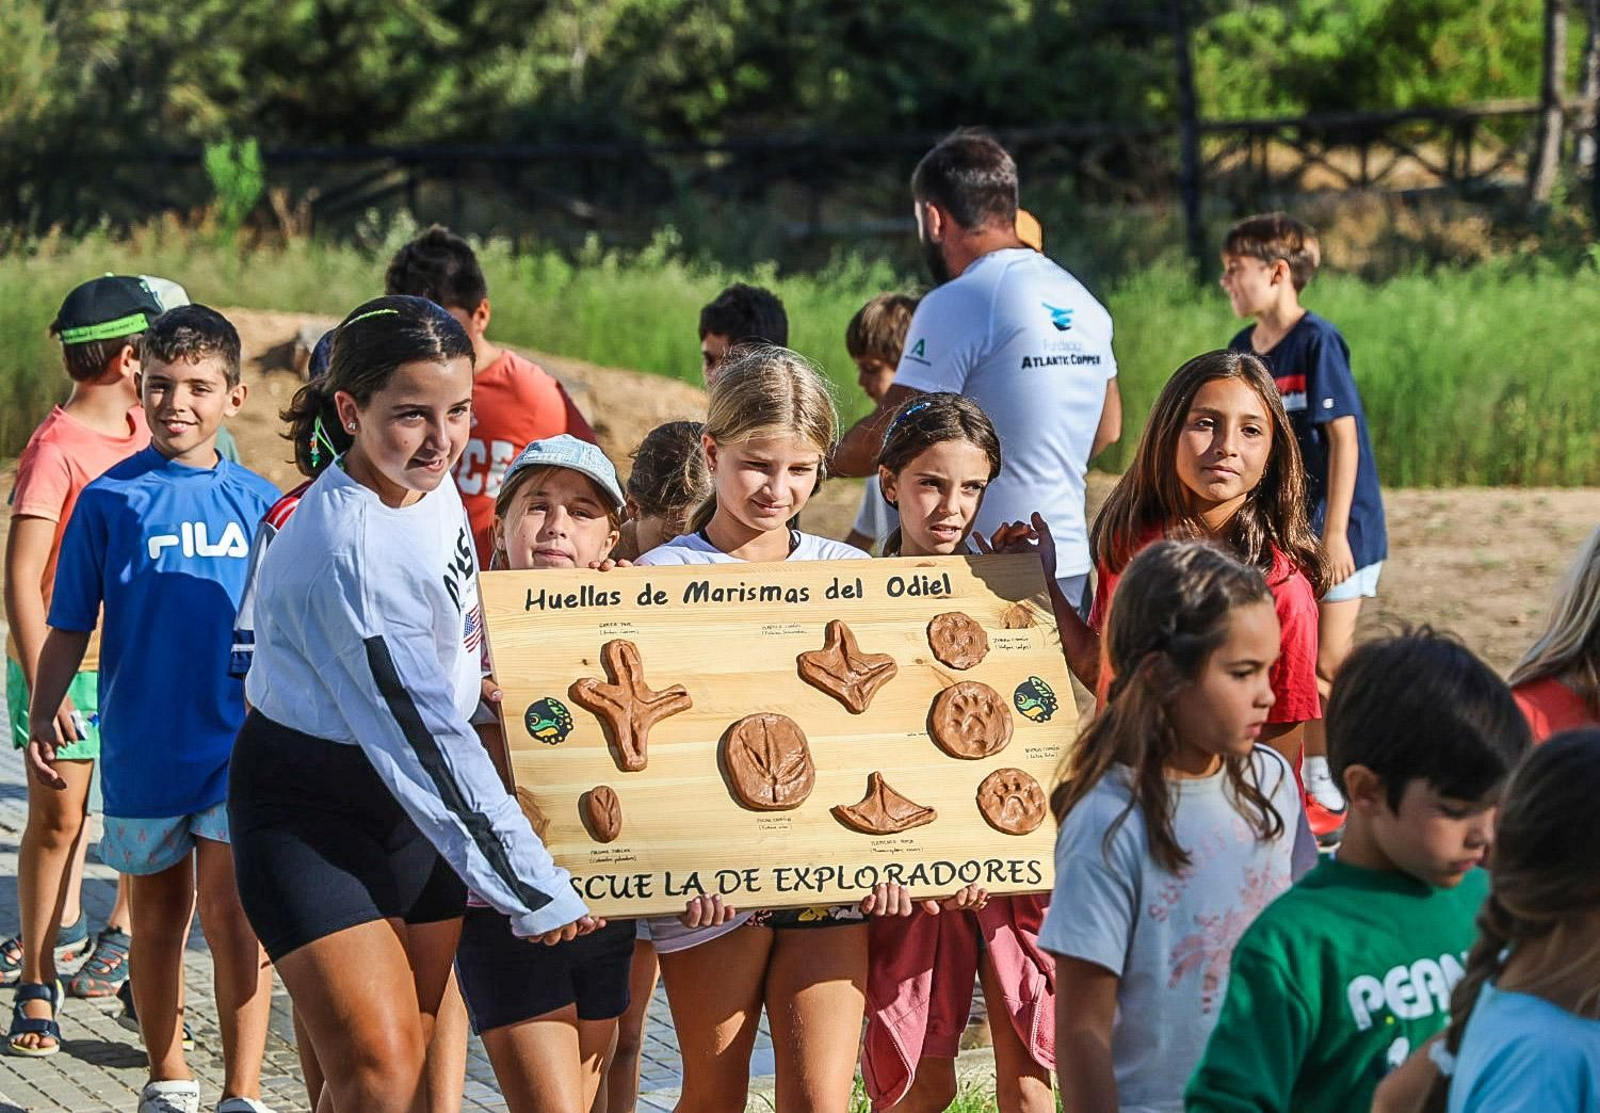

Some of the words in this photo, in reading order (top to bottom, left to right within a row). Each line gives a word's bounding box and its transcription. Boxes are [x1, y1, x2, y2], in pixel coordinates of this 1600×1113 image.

[147, 520, 250, 560] FILA
[524, 584, 622, 612] Huellas
[636, 582, 669, 606] de
[682, 579, 811, 604] Marismas
[824, 576, 864, 600] del
[885, 572, 953, 599] Odiel
[714, 868, 763, 895] DE
[772, 859, 1043, 893] EXPLORADORES
[1347, 951, 1469, 1031] PEAN
